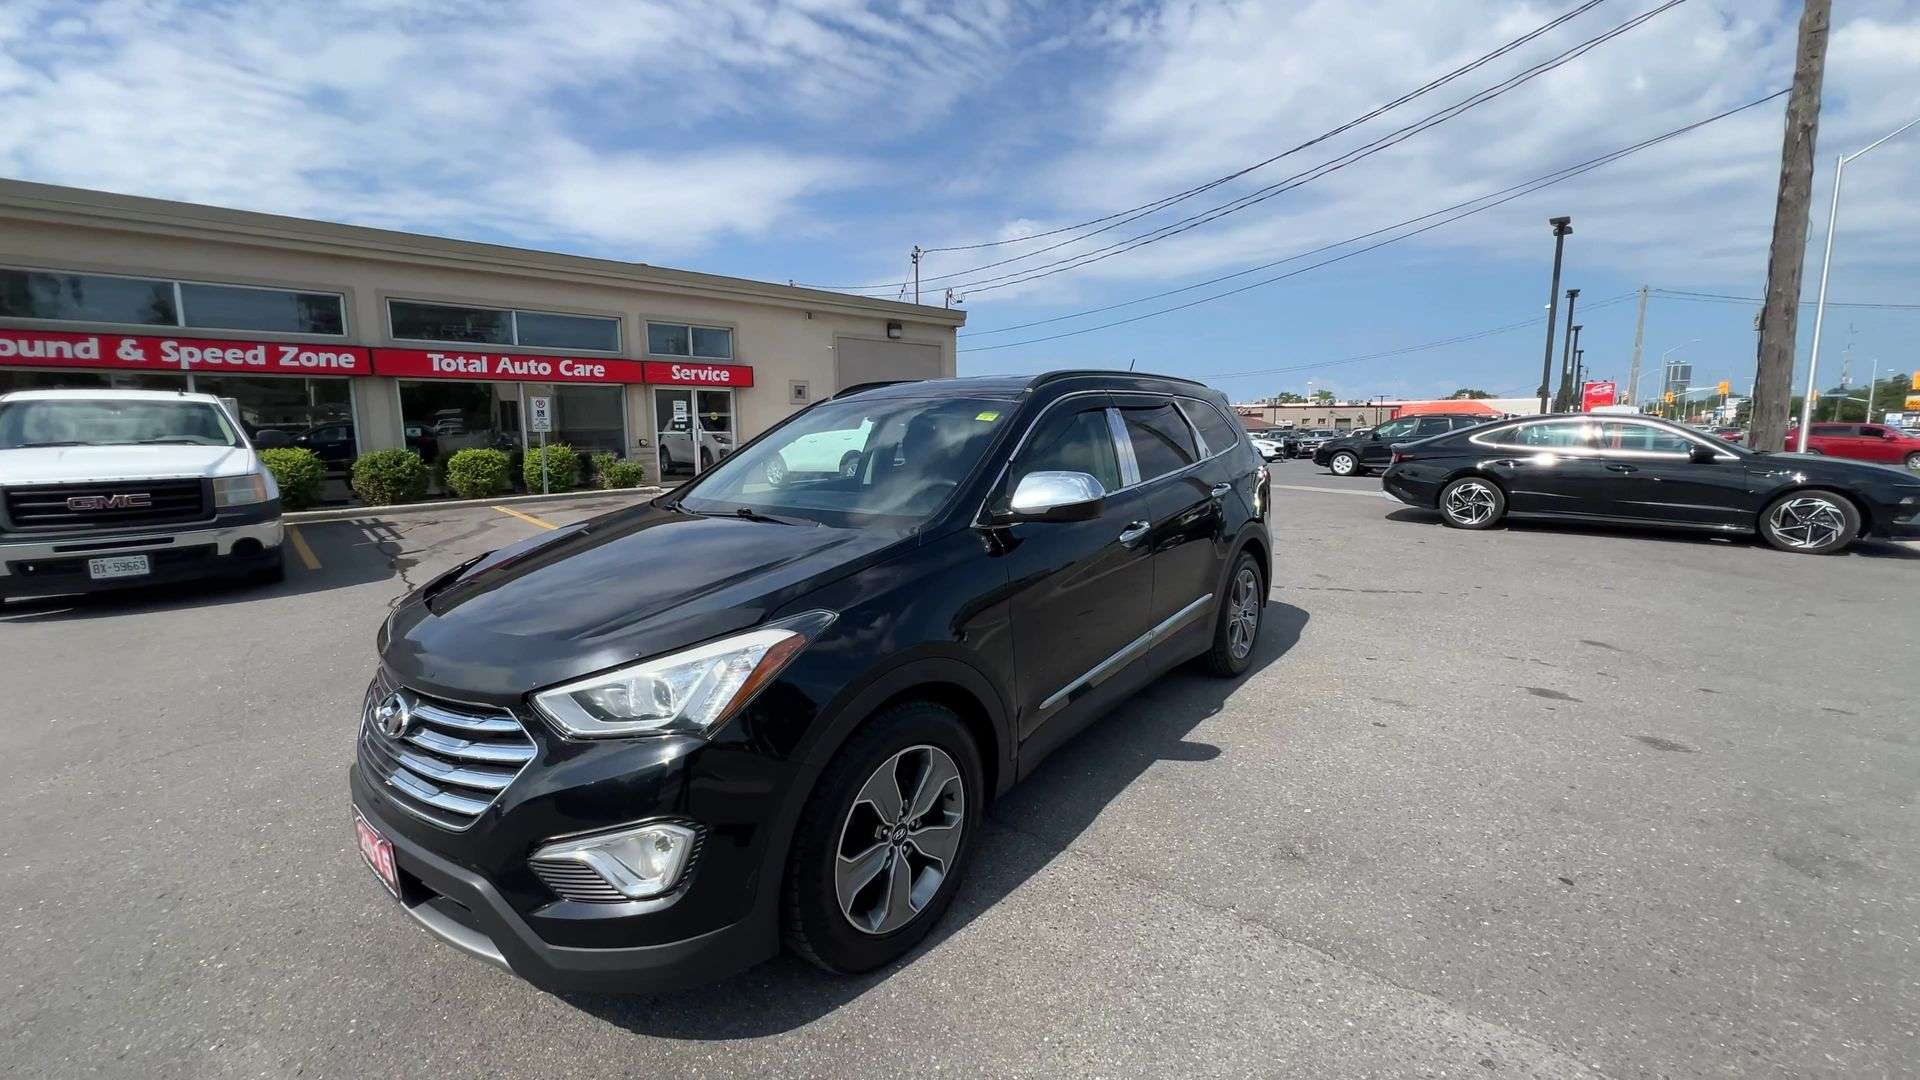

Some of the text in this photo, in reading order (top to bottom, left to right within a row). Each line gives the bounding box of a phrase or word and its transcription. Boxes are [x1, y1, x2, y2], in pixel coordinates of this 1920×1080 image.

[117, 338, 146, 361] &
[160, 340, 266, 370] Speed
[278, 347, 356, 368] Zone
[427, 353, 606, 378] Total Auto Care
[671, 365, 731, 384] Service
[66, 493, 152, 511] GMC
